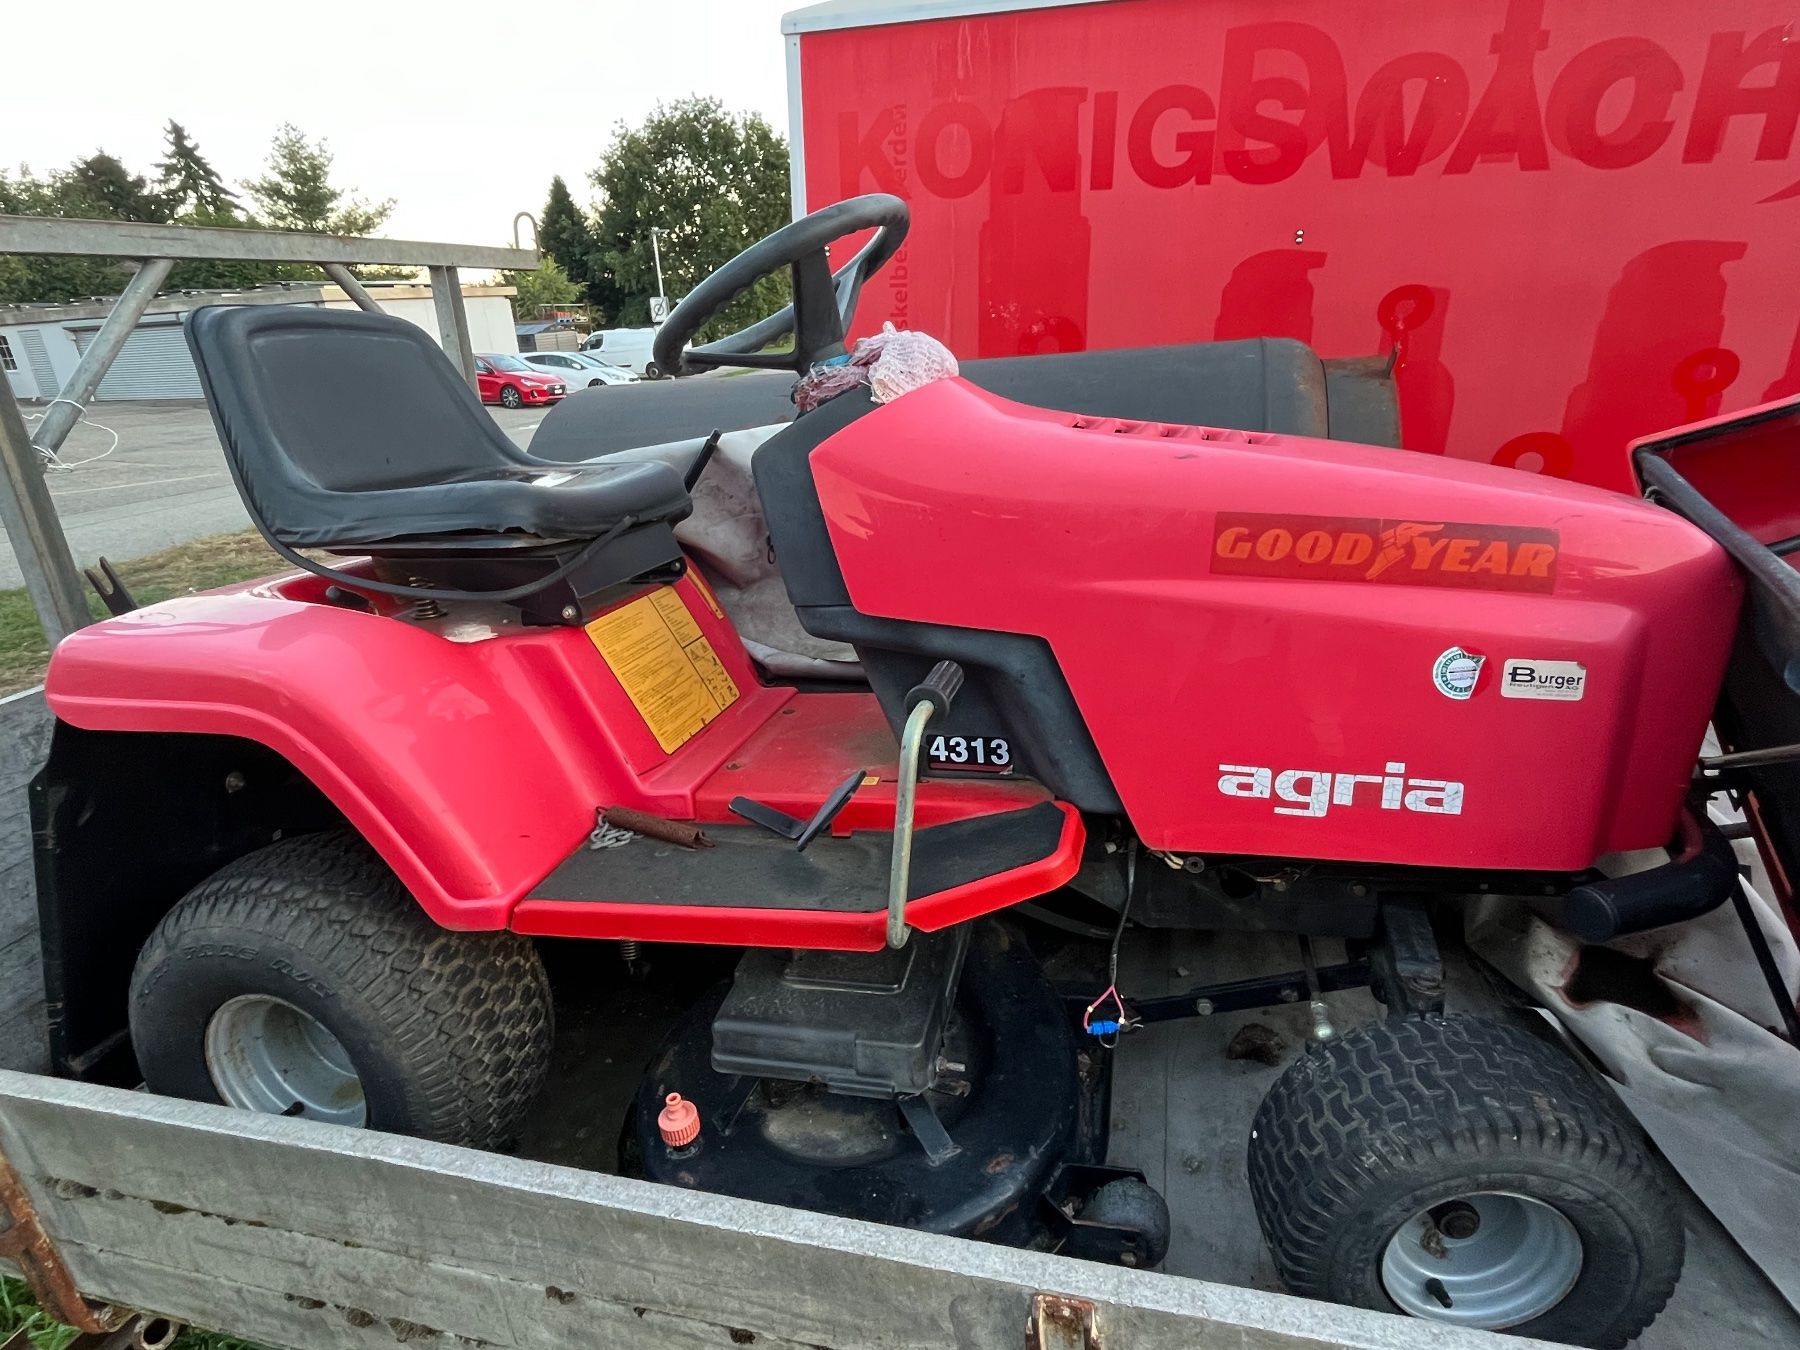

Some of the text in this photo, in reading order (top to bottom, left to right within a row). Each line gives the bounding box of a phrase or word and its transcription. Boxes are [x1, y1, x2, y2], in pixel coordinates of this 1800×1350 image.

[1508, 666, 1583, 689] Burger
[929, 736, 1010, 765] 4313
[1217, 761, 1465, 818] agria
